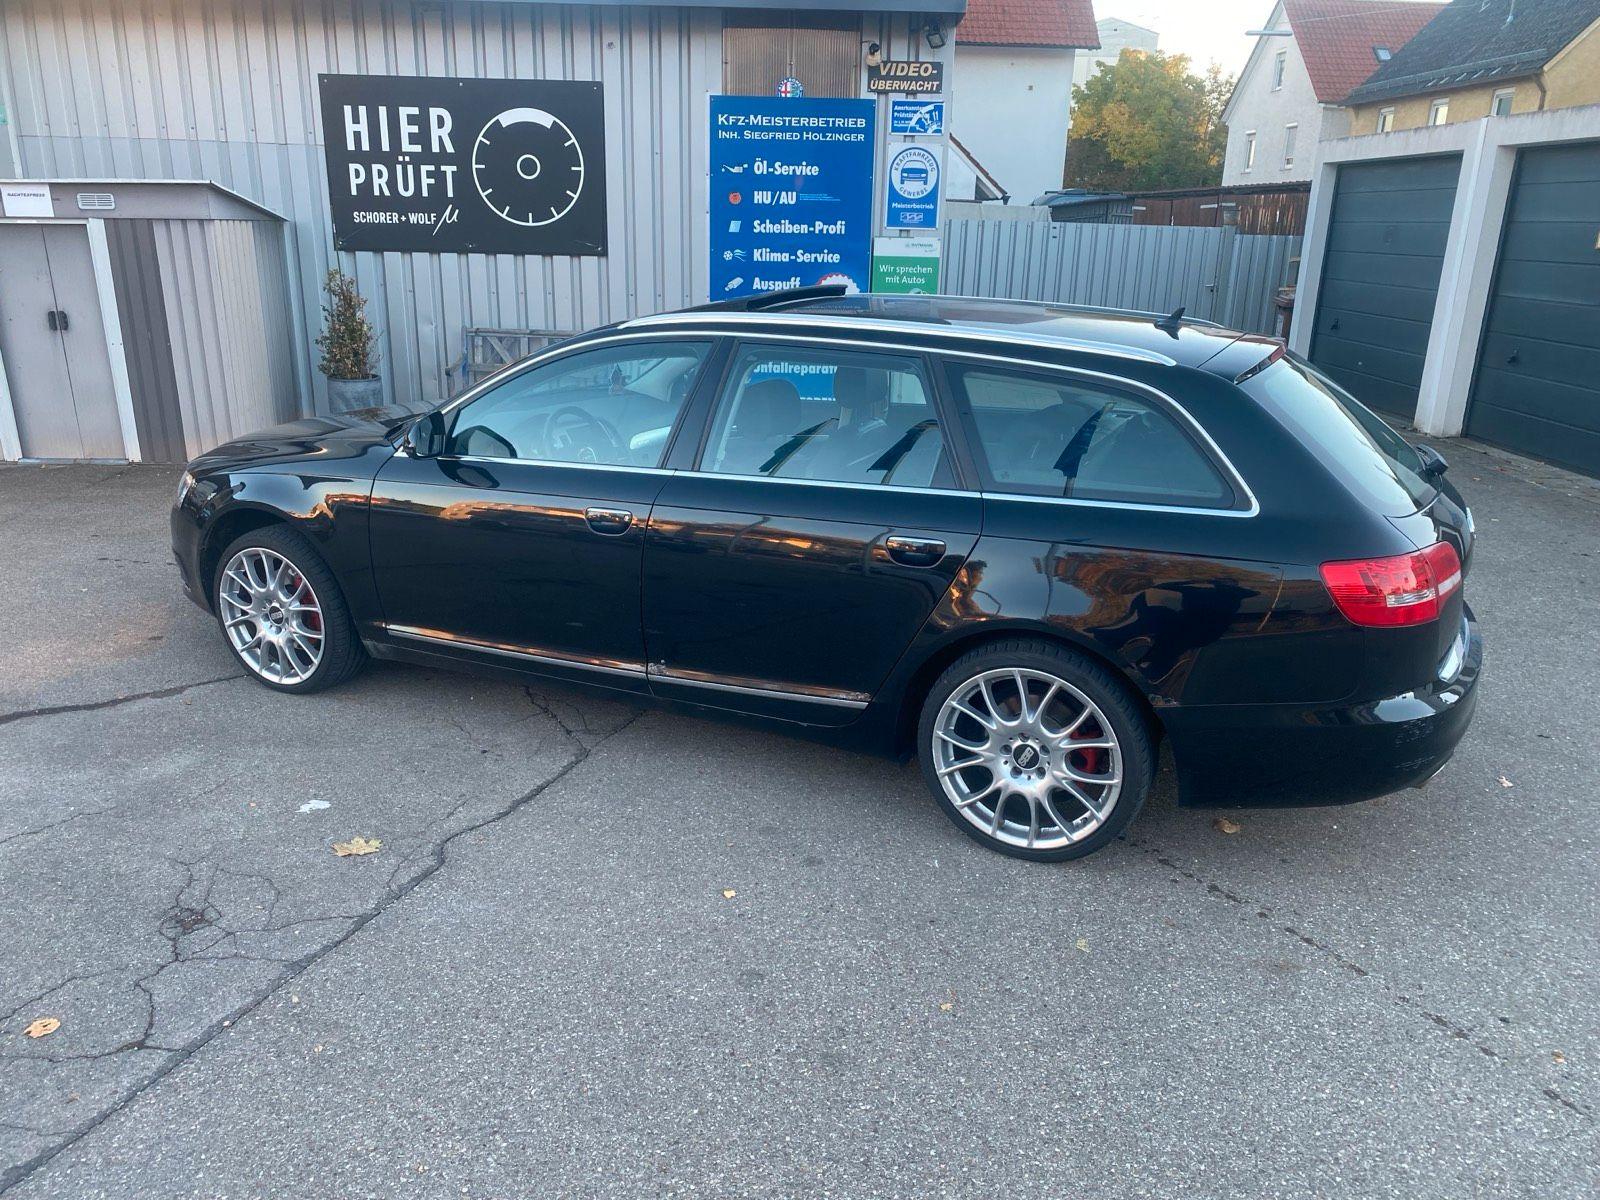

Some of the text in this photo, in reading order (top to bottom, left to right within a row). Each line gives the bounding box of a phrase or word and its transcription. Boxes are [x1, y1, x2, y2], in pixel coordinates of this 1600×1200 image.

[880, 62, 937, 77] VIDEO-
[870, 78, 940, 91] ÜBERWACHT
[343, 105, 456, 154] HIER
[743, 130, 800, 141] SIEGFRIED
[803, 131, 865, 142] HOLZINGER
[753, 157, 820, 176] Öl-Service
[894, 151, 936, 172] KRAFTFAHRZEUG
[348, 155, 458, 198] PRÜFT
[899, 186, 928, 197] GEWERBE
[892, 202, 935, 210] Meisterbetrieb
[353, 211, 400, 224] SCHORER
[408, 212, 437, 225] WOLF
[753, 218, 846, 235] Scheiben-Profi
[753, 247, 841, 263] Klima-Service
[879, 264, 933, 275] Wir sprechen
[752, 276, 801, 291] Auspuff
[885, 275, 926, 284] mit Autos
